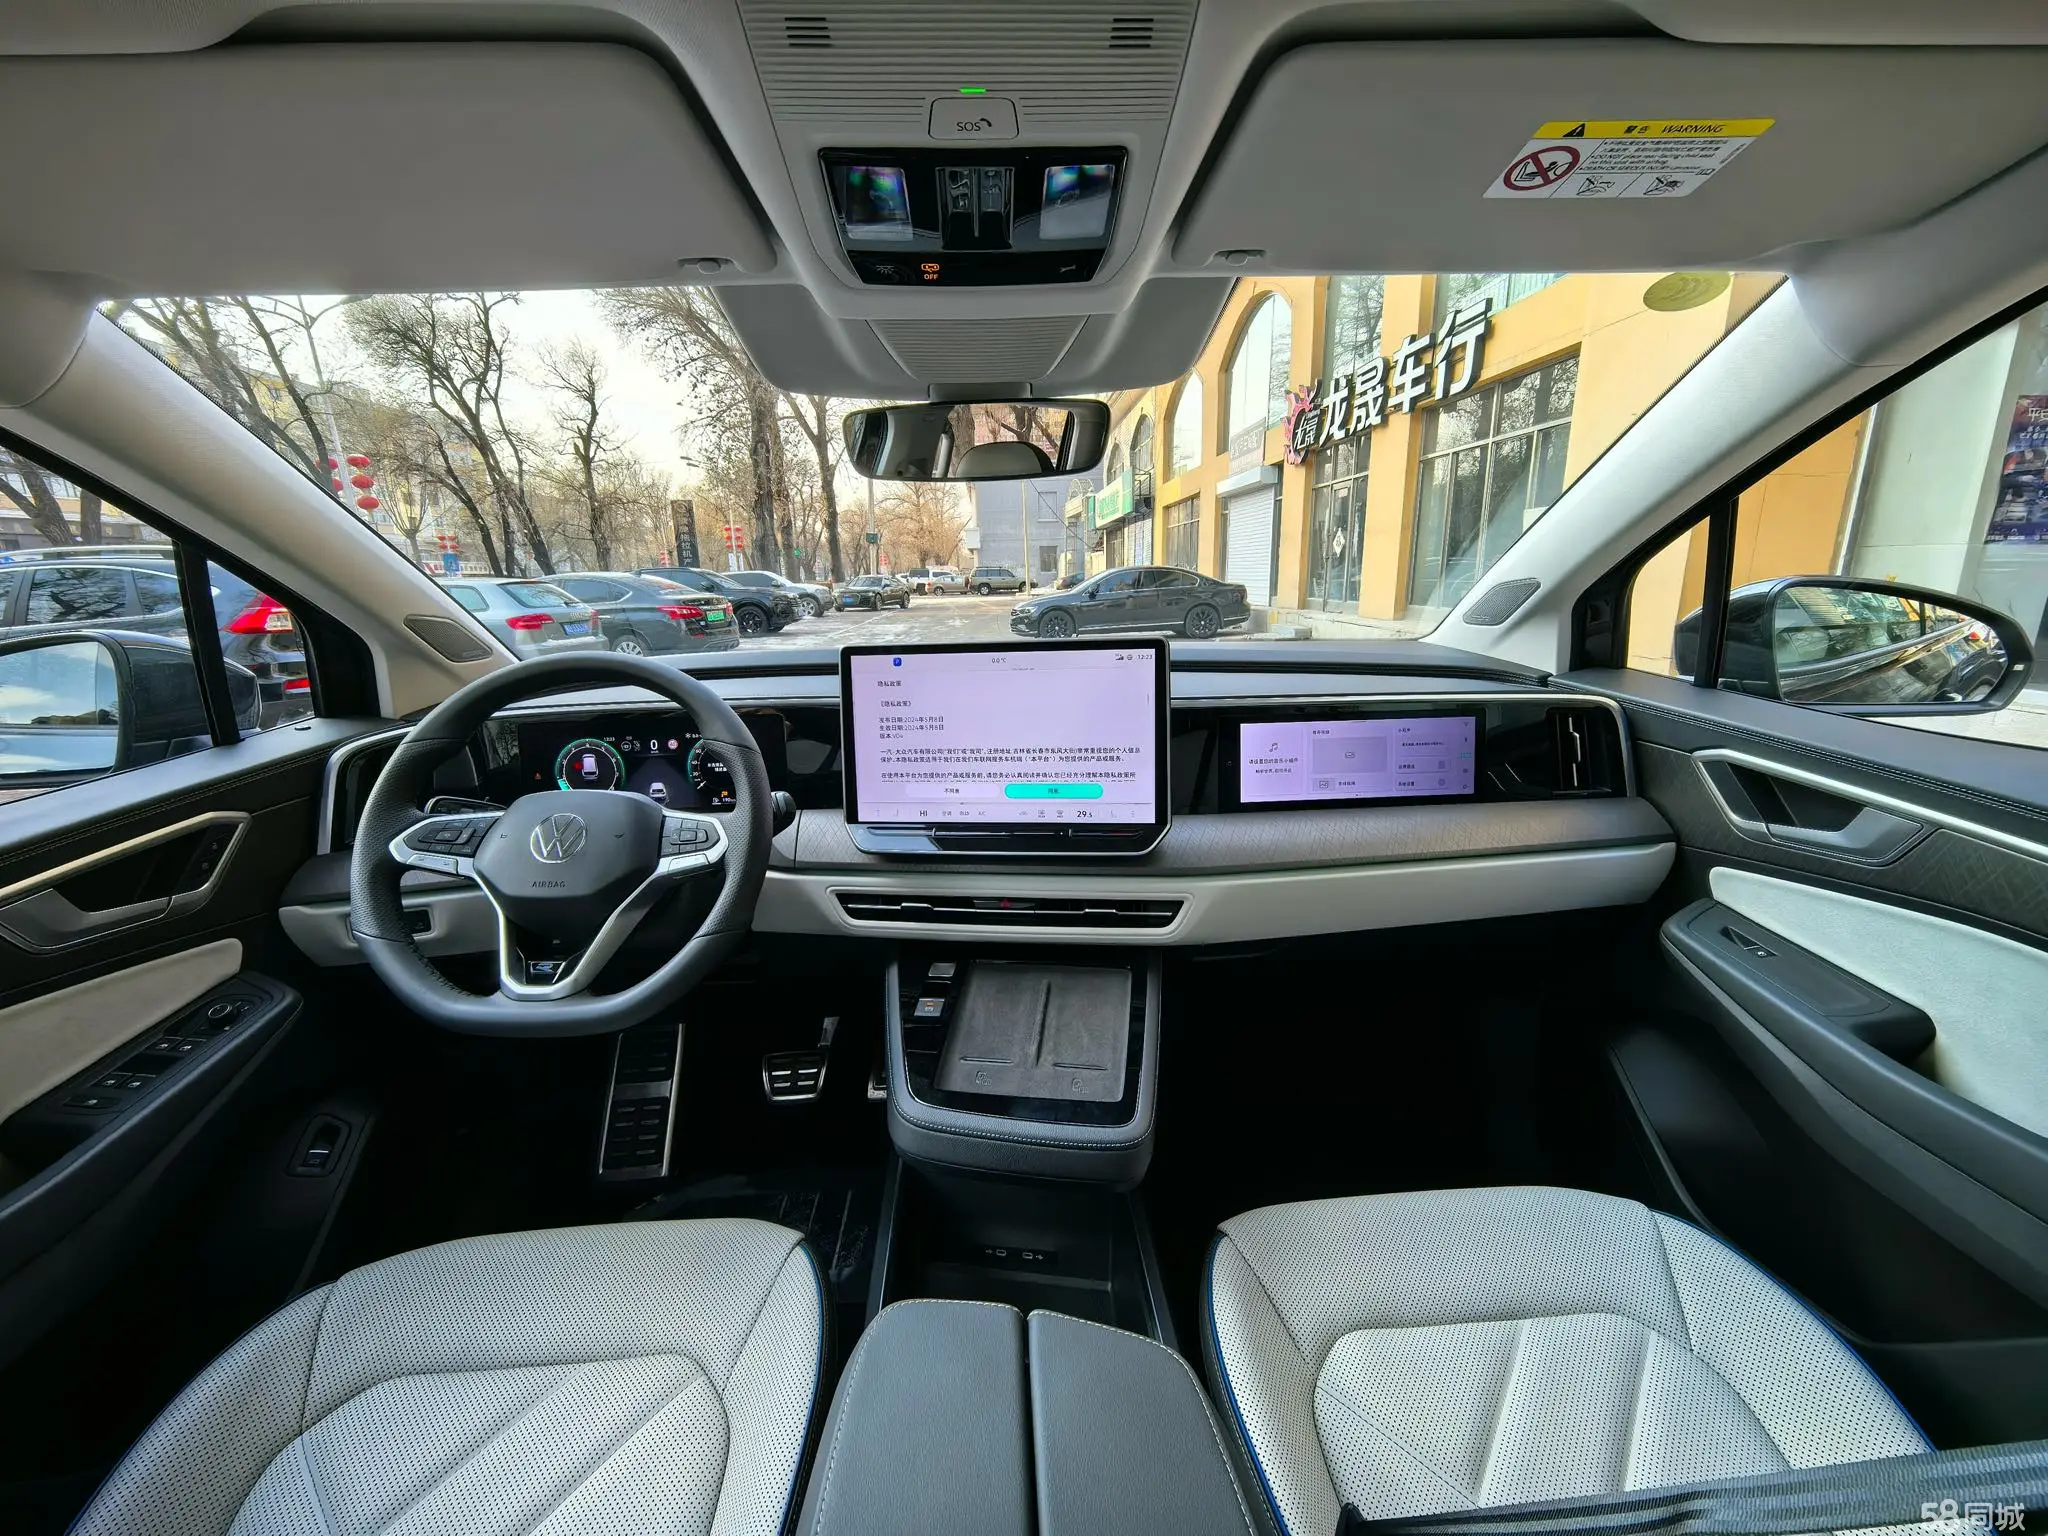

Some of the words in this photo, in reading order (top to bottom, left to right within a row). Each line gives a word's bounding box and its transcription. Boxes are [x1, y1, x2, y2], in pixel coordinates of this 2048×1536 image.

[956, 120, 981, 132] SOS
[1661, 124, 1727, 134] WARNING
[1319, 298, 1493, 448] 龙晟车行
[650, 739, 658, 750] 0
[531, 880, 566, 888] AIRBAG
